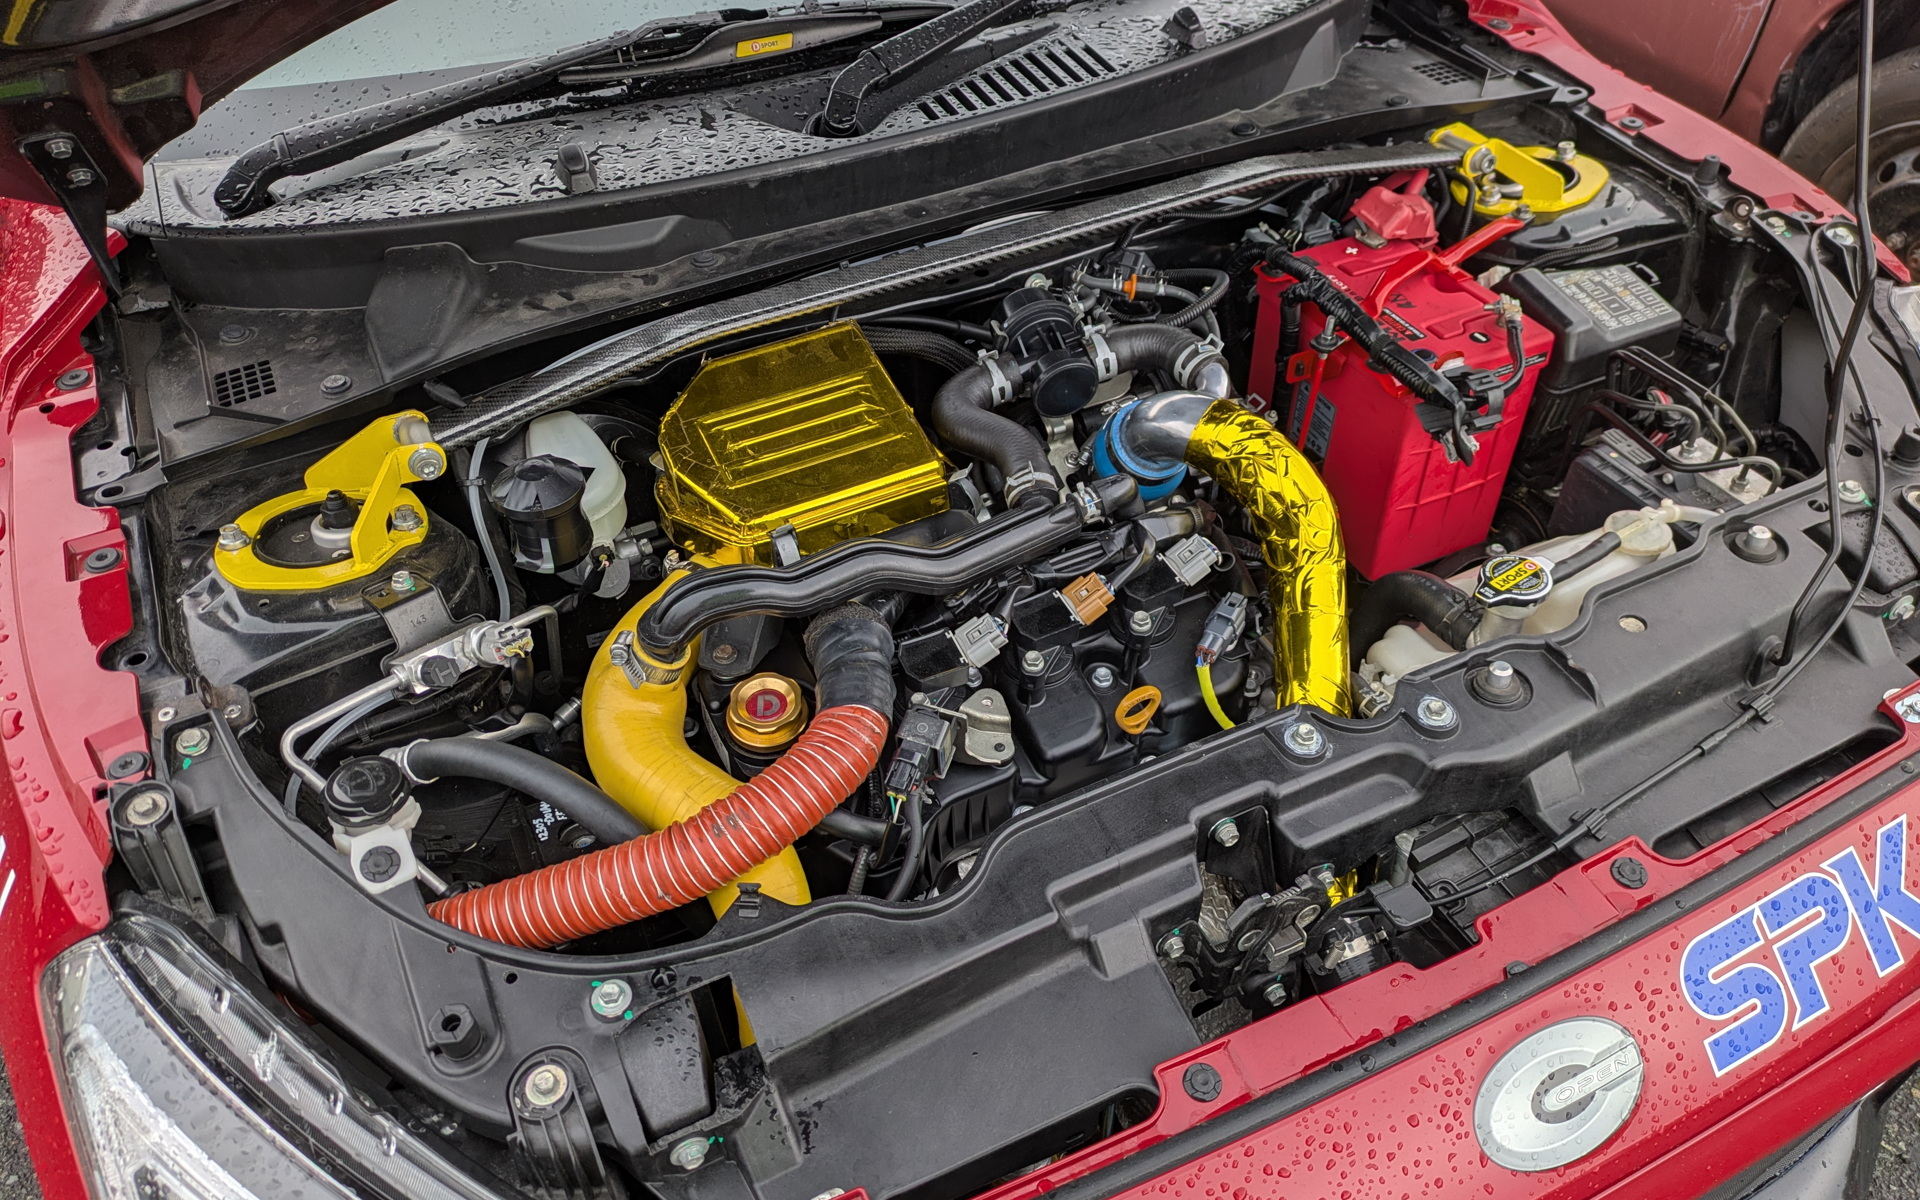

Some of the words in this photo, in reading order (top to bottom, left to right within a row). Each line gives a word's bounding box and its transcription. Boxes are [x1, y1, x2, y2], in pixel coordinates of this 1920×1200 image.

[1326, 274, 1364, 302] Battery
[1495, 567, 1528, 588] SPORT
[435, 661, 457, 684] H
[757, 694, 780, 716] D
[532, 818, 549, 841] 12305
[1680, 813, 1920, 1078] SPK
[1555, 1053, 1630, 1104] OPEN
